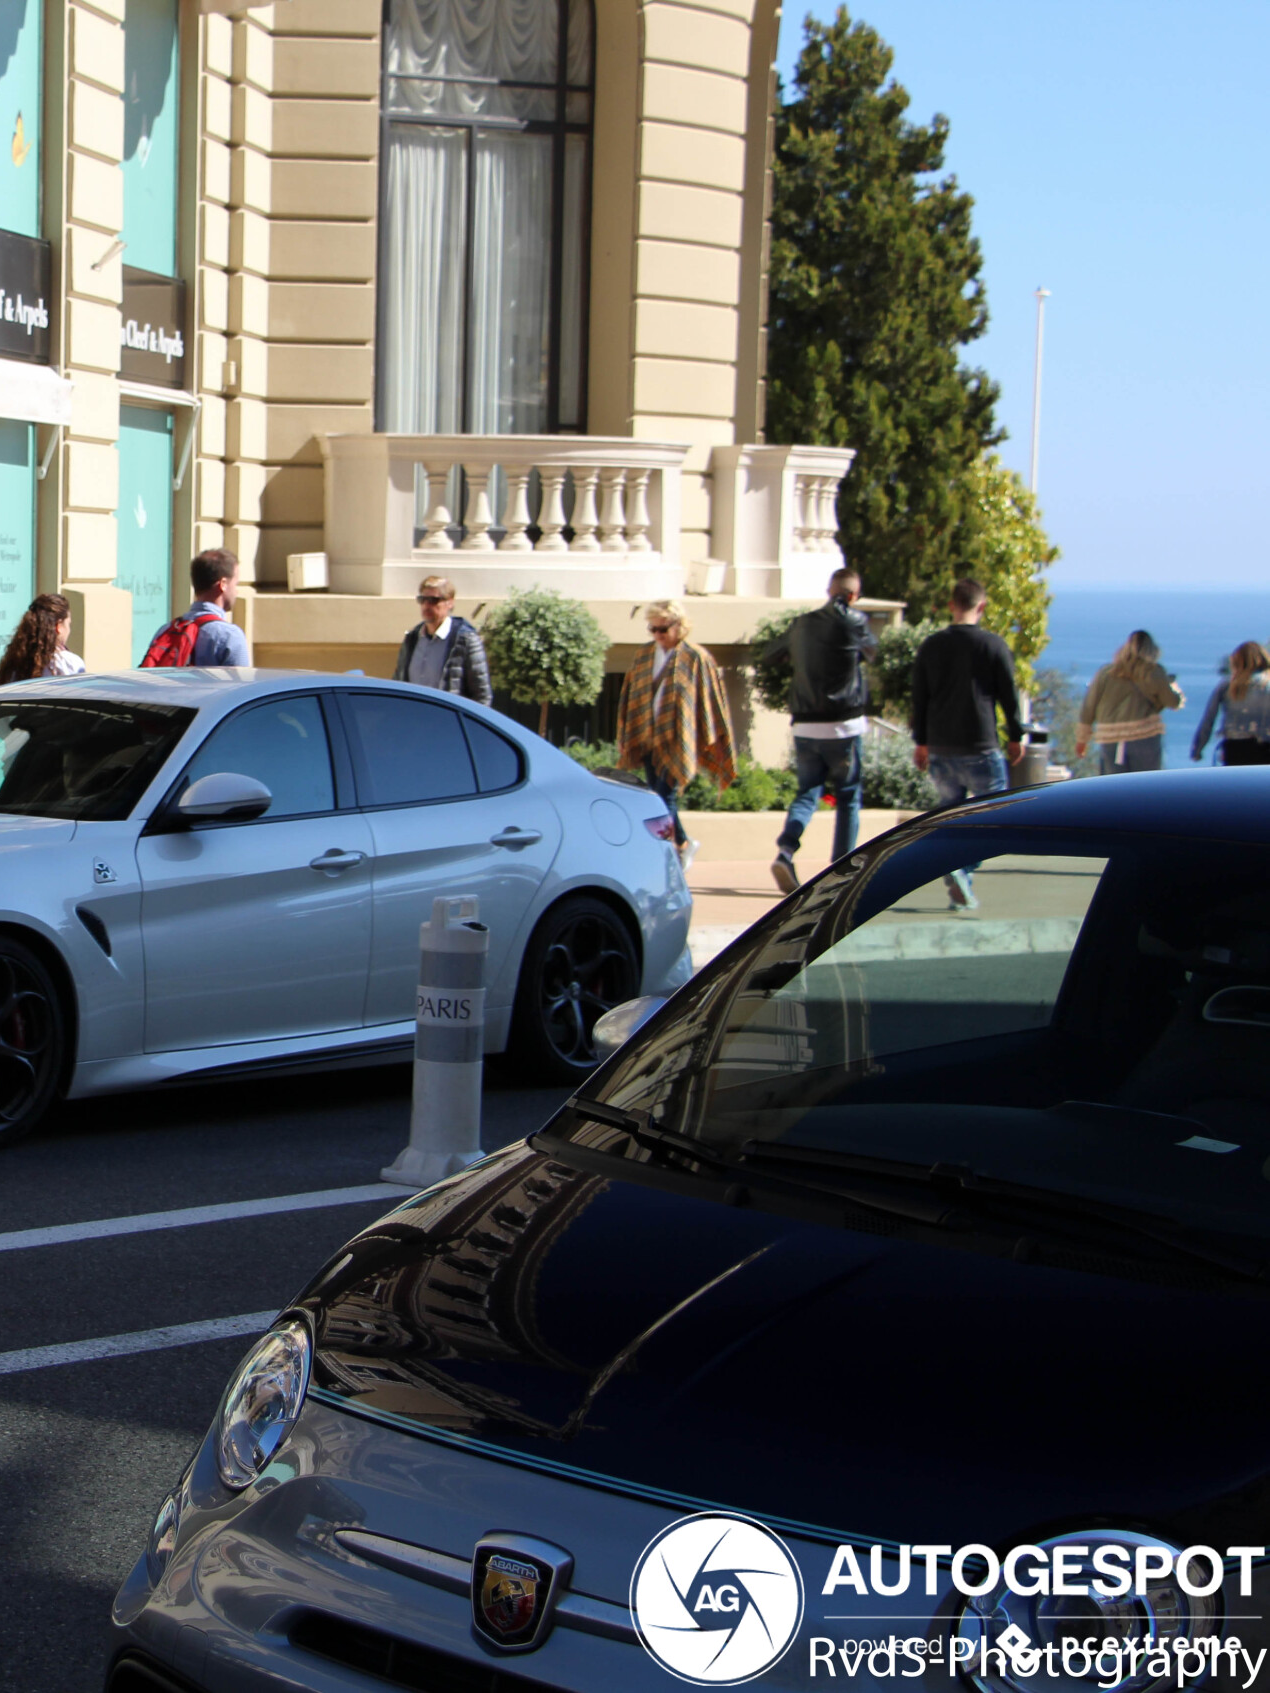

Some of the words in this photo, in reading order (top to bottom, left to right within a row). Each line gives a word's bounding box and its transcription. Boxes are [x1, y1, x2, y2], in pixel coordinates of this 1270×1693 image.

[4, 297, 14, 322] &
[14, 293, 48, 336] Arpels
[126, 319, 151, 351] Cleef
[149, 330, 158, 353] &
[158, 326, 184, 364] Arpels
[491, 1559, 535, 1578] ABARTH
